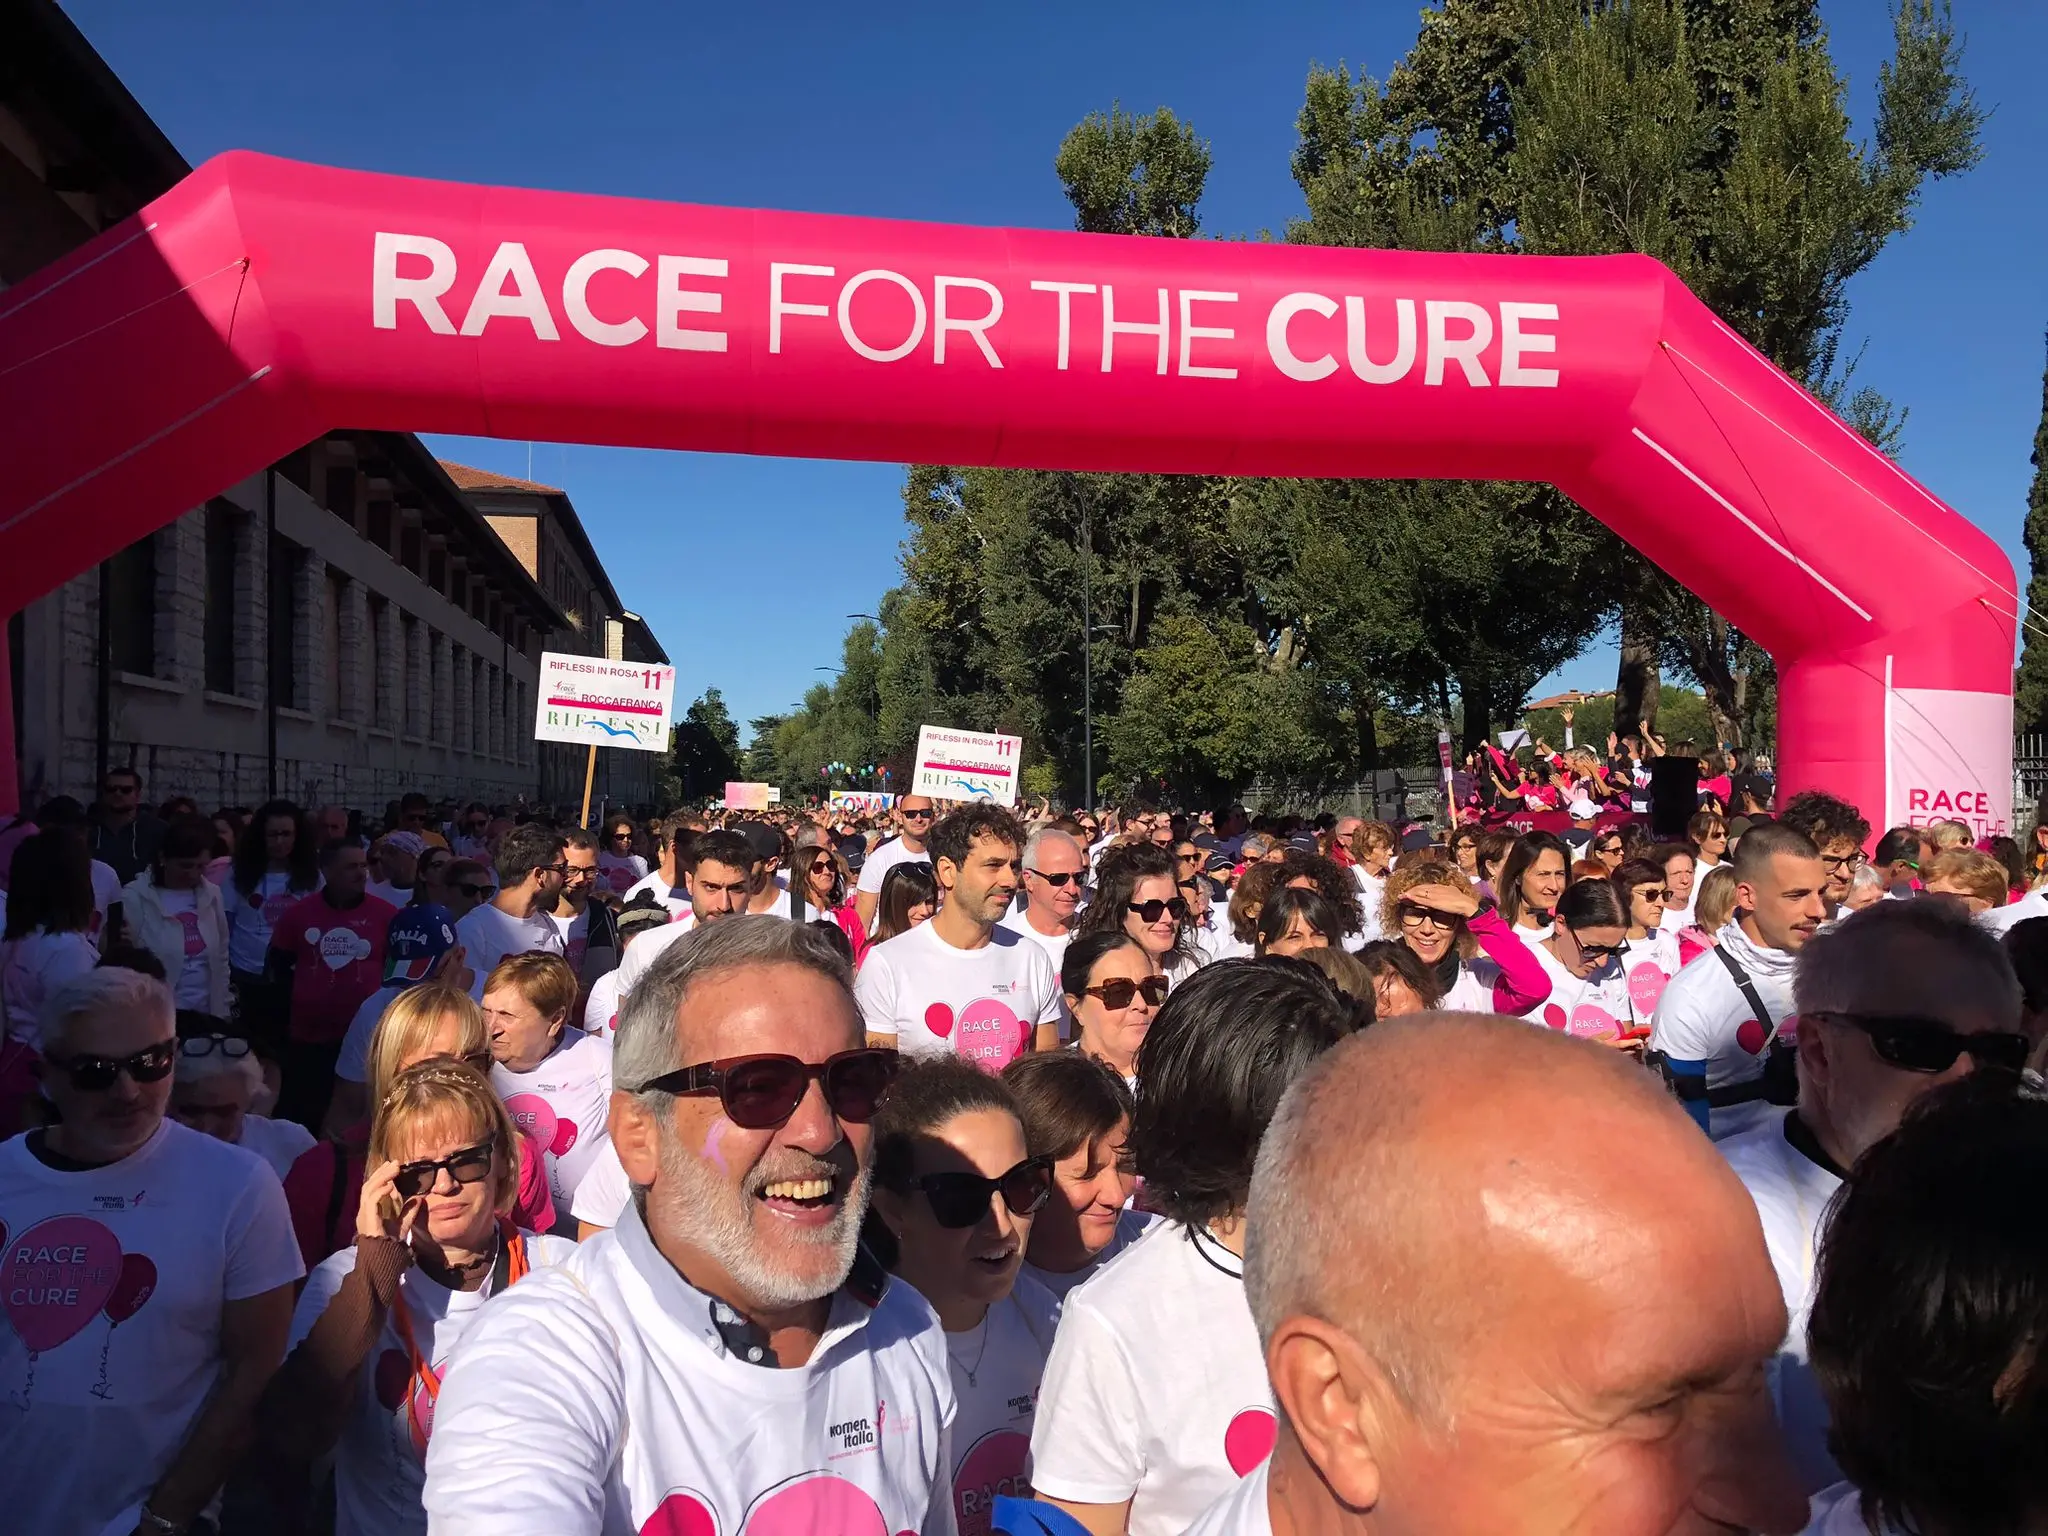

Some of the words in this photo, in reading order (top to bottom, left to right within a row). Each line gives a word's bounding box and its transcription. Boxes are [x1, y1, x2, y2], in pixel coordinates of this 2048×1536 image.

[372, 230, 729, 353] RACE
[768, 261, 1005, 370] FOR
[1030, 280, 1239, 380] THE
[1266, 291, 1560, 388] CURE
[550, 661, 594, 674] RIFLESSI
[597, 666, 607, 675] IN
[609, 667, 638, 679] ROSA
[641, 670, 661, 690] 11
[581, 693, 663, 710] ROCCAFRANCA
[926, 732, 961, 742] RIFLESSI
[971, 738, 994, 747] ROSA
[996, 739, 1012, 757] 11
[949, 758, 1012, 772] ROCCAFRANCA
[1909, 788, 1989, 814] RACE
[390, 929, 428, 945] ITALIA
[1631, 974, 1656, 984] RACE
[1634, 989, 1657, 1000] CURE
[962, 1018, 1001, 1033] RACE
[1575, 1019, 1604, 1029] RACE
[964, 1046, 1002, 1059] CURE
[509, 1112, 536, 1124] ACE
[15, 1247, 88, 1264] RACE
[12, 1268, 61, 1285] FOR
[70, 1267, 110, 1286] THE
[9, 1288, 79, 1306] CURE
[844, 1431, 874, 1449] italia
[961, 1474, 1031, 1518] RACE
